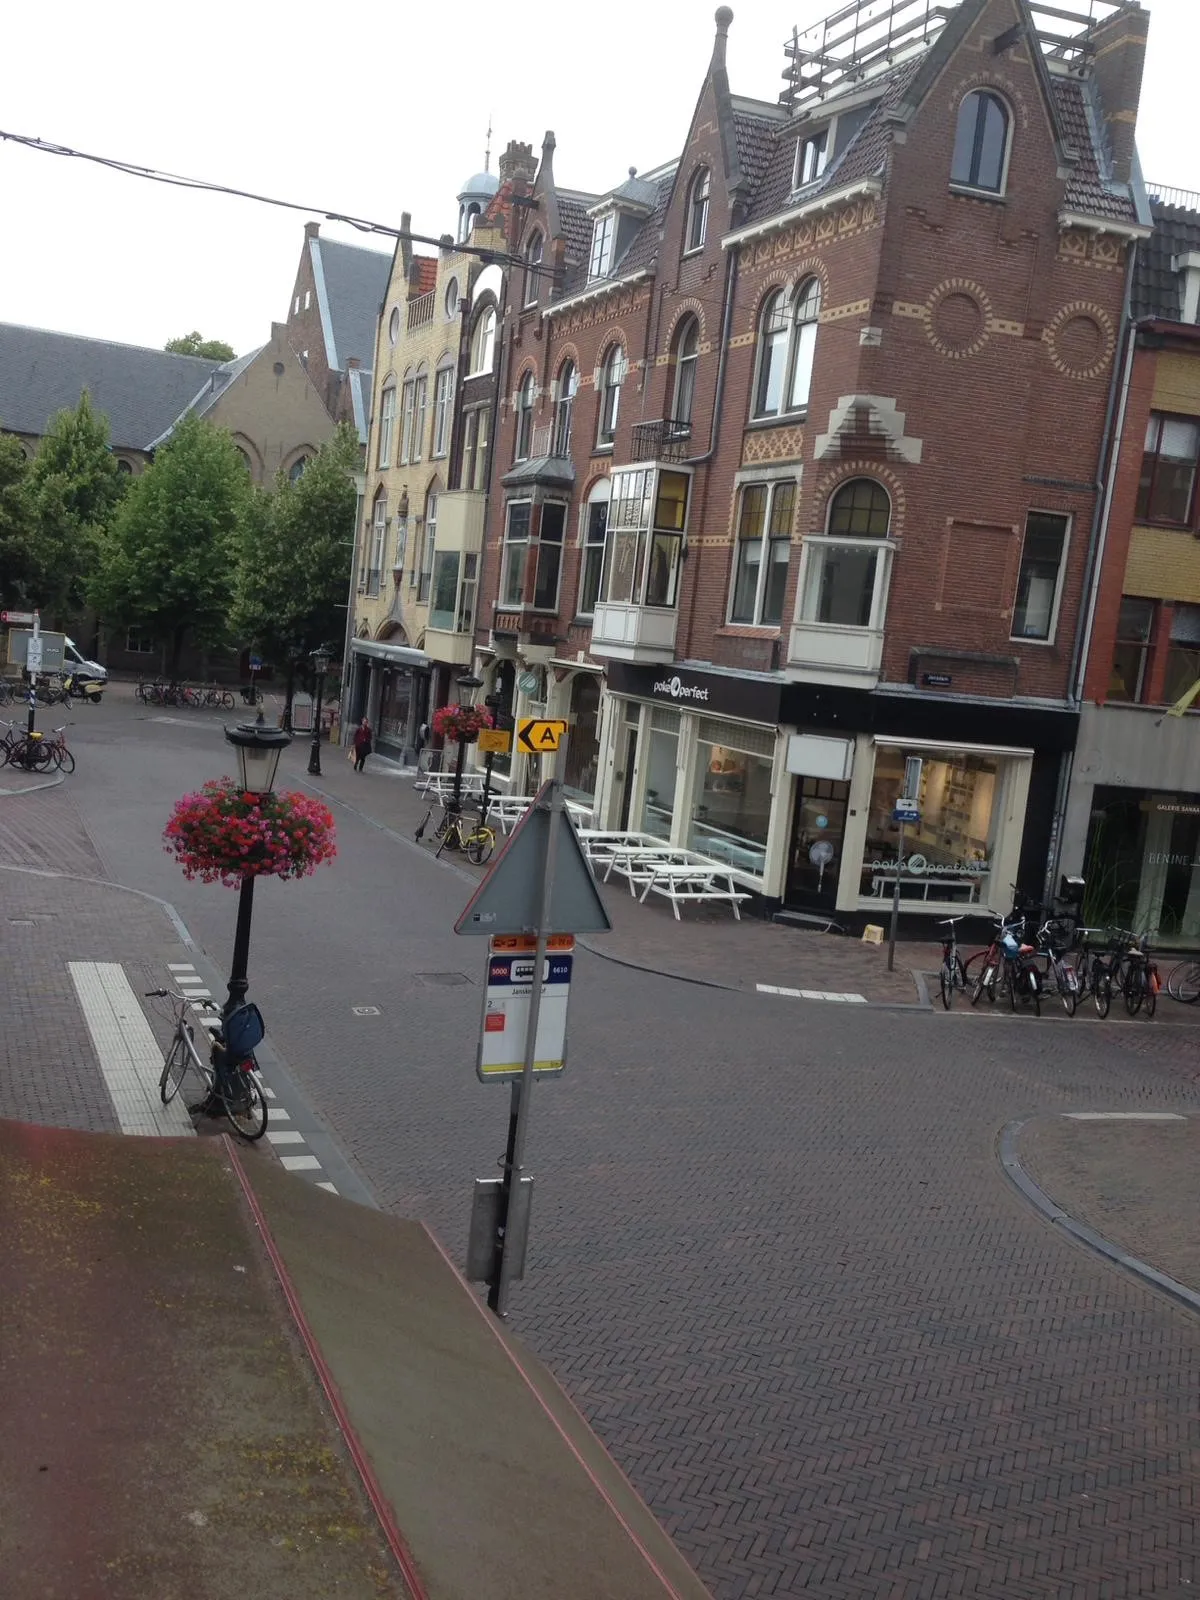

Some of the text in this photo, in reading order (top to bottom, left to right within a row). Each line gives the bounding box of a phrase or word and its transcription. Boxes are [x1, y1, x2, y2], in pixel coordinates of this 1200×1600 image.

[654, 679, 709, 700] poké perfect
[540, 727, 555, 743] A
